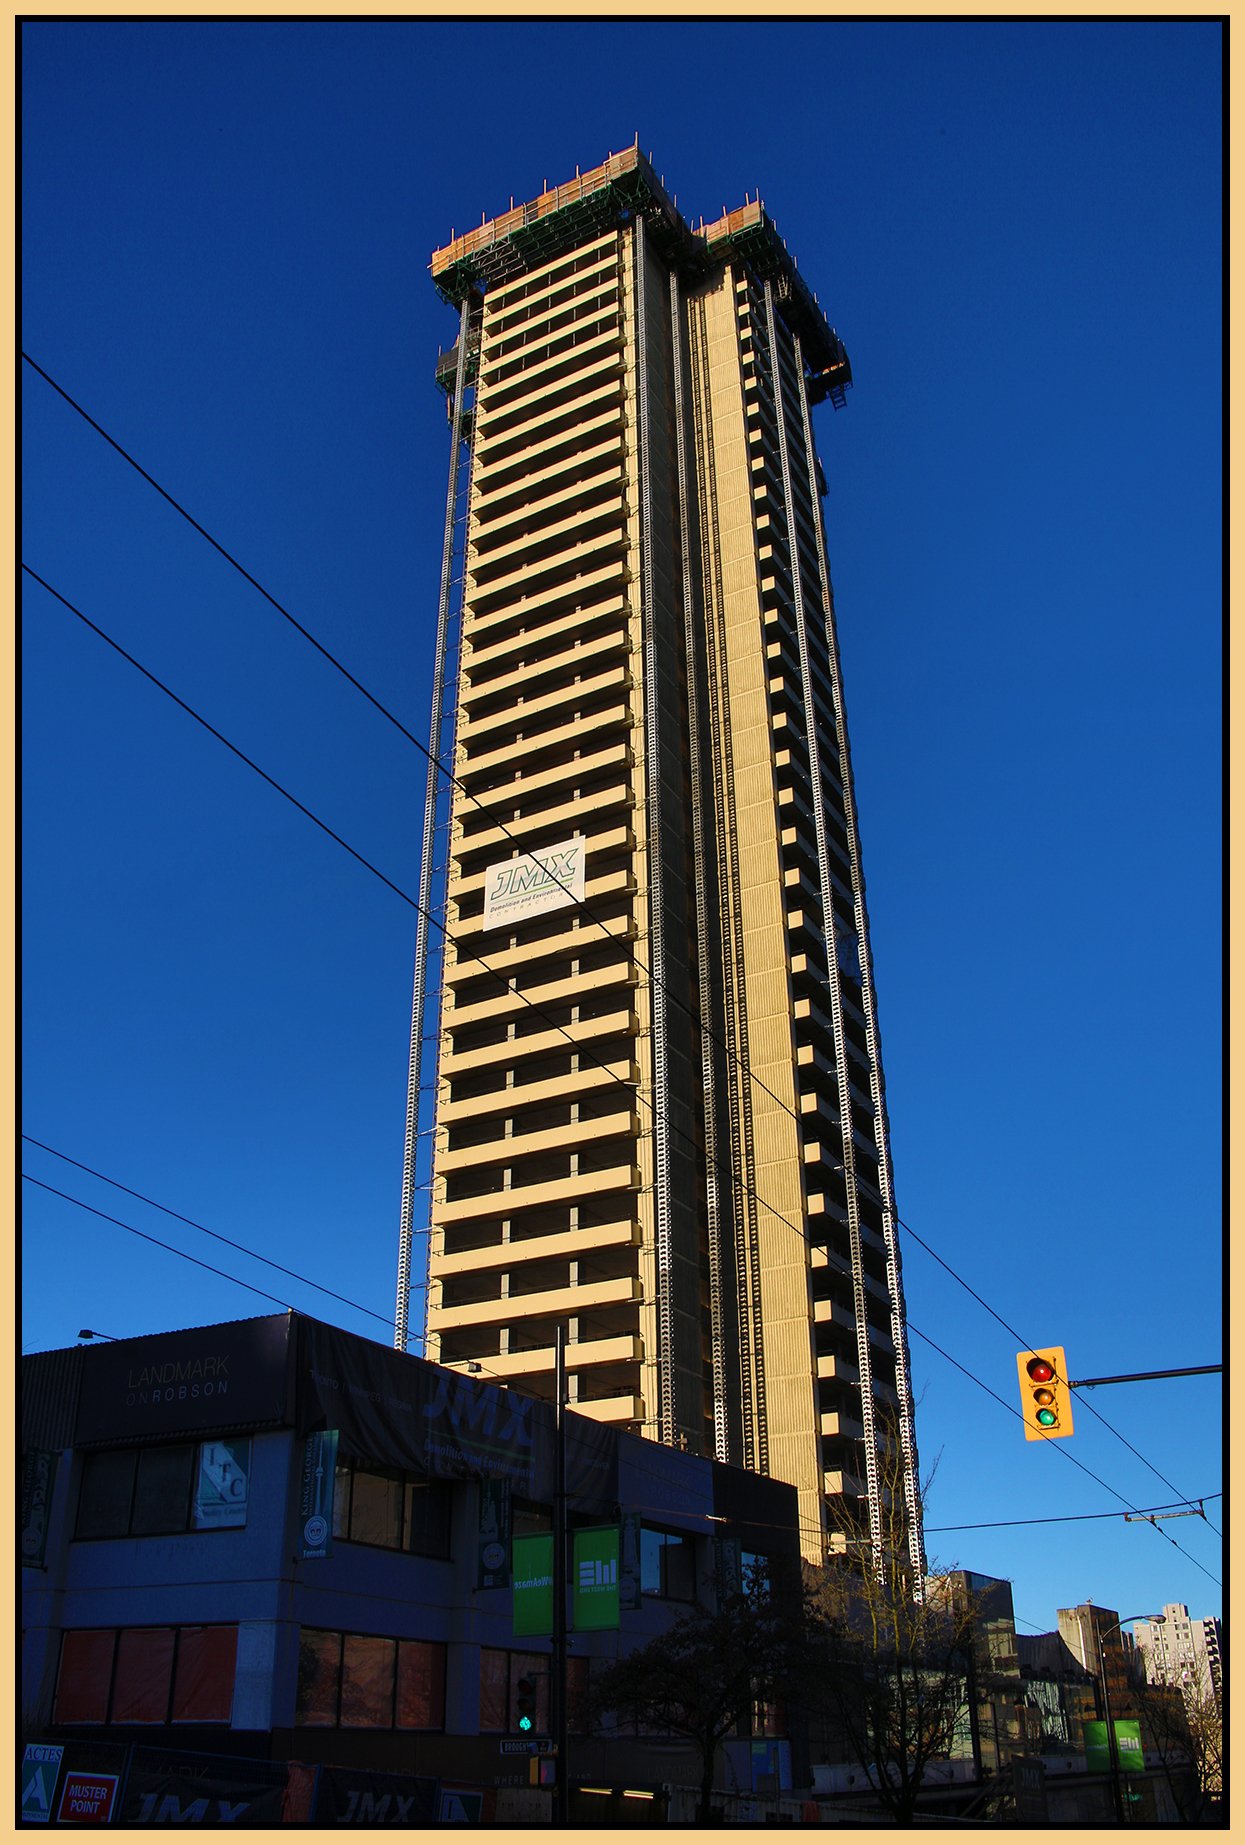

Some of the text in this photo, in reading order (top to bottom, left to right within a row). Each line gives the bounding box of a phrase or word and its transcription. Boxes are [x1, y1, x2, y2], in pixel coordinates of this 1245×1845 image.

[490, 847, 580, 901] JMX
[489, 891, 564, 919] CONTRACTOR
[490, 899, 520, 912] Demolition
[521, 895, 532, 904] and
[128, 1354, 232, 1389] LANDMARK
[126, 1380, 229, 1407] ON ROBSON
[422, 1369, 536, 1448] JMX
[300, 1486, 310, 1516] KING
[25, 1745, 62, 1761] ACTES
[69, 1784, 109, 1800] MUSTER
[494, 1776, 525, 1785] WHERE
[70, 1799, 102, 1815] POINT
[134, 1792, 253, 1822] JMX
[337, 1790, 416, 1822] JMX
